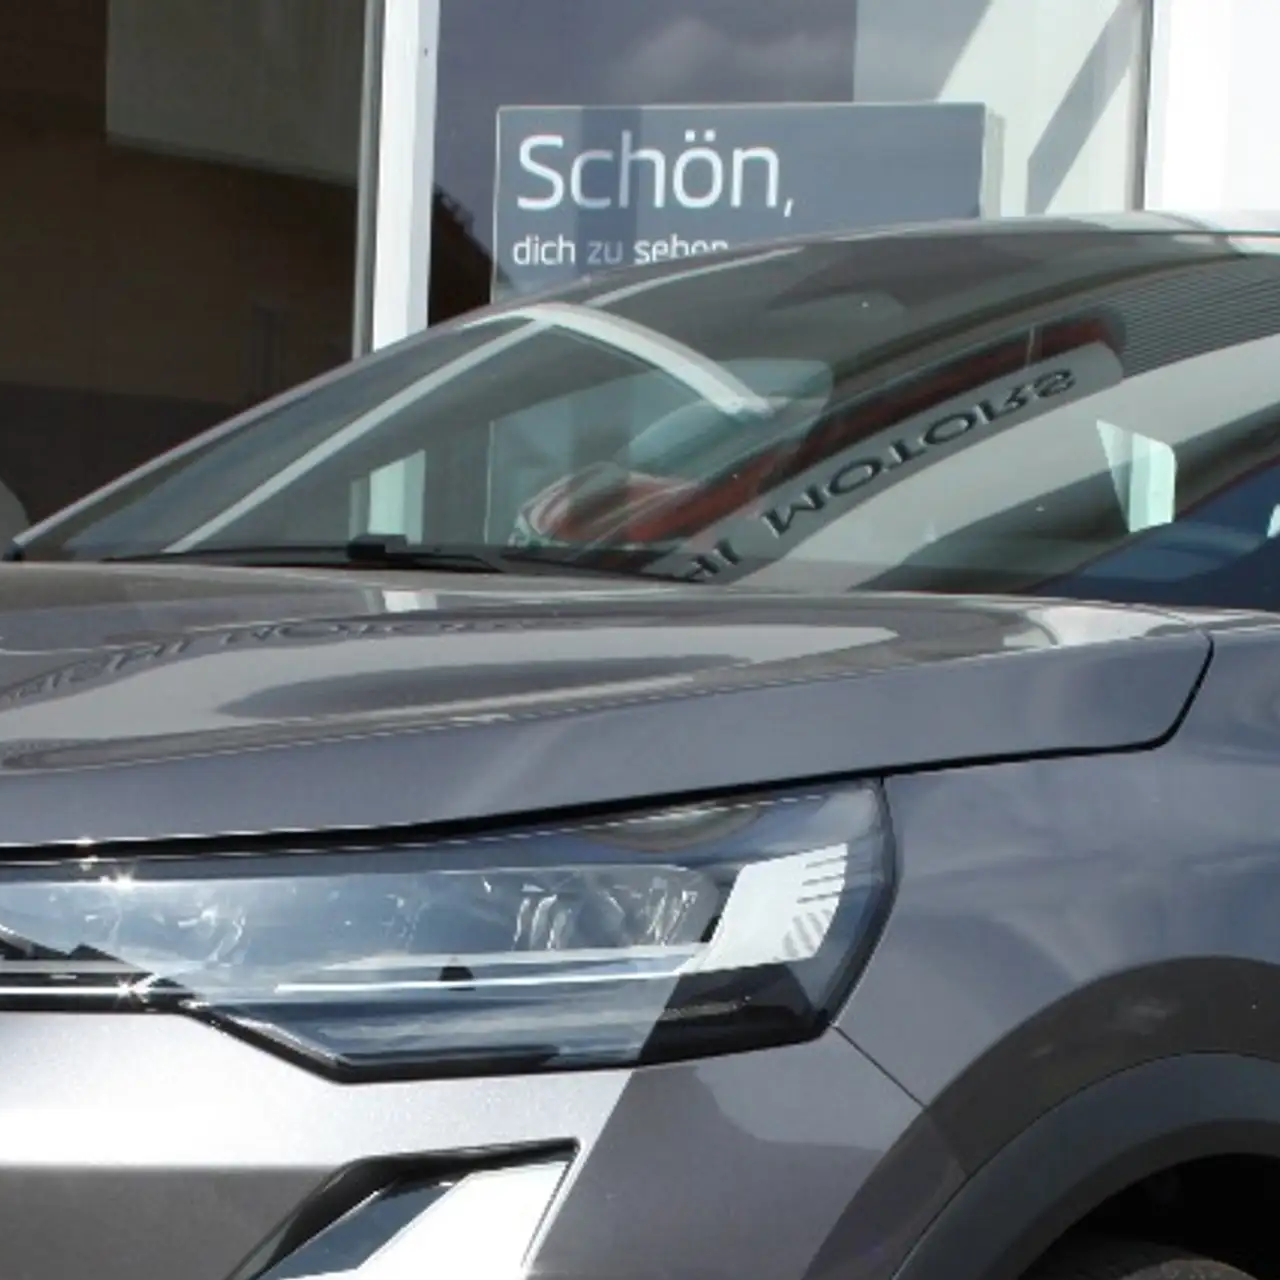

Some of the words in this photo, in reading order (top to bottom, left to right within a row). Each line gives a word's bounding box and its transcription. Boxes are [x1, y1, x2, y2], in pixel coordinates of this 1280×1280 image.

[516, 129, 794, 217] Schön,
[513, 234, 576, 266] dich
[586, 240, 623, 265] zu
